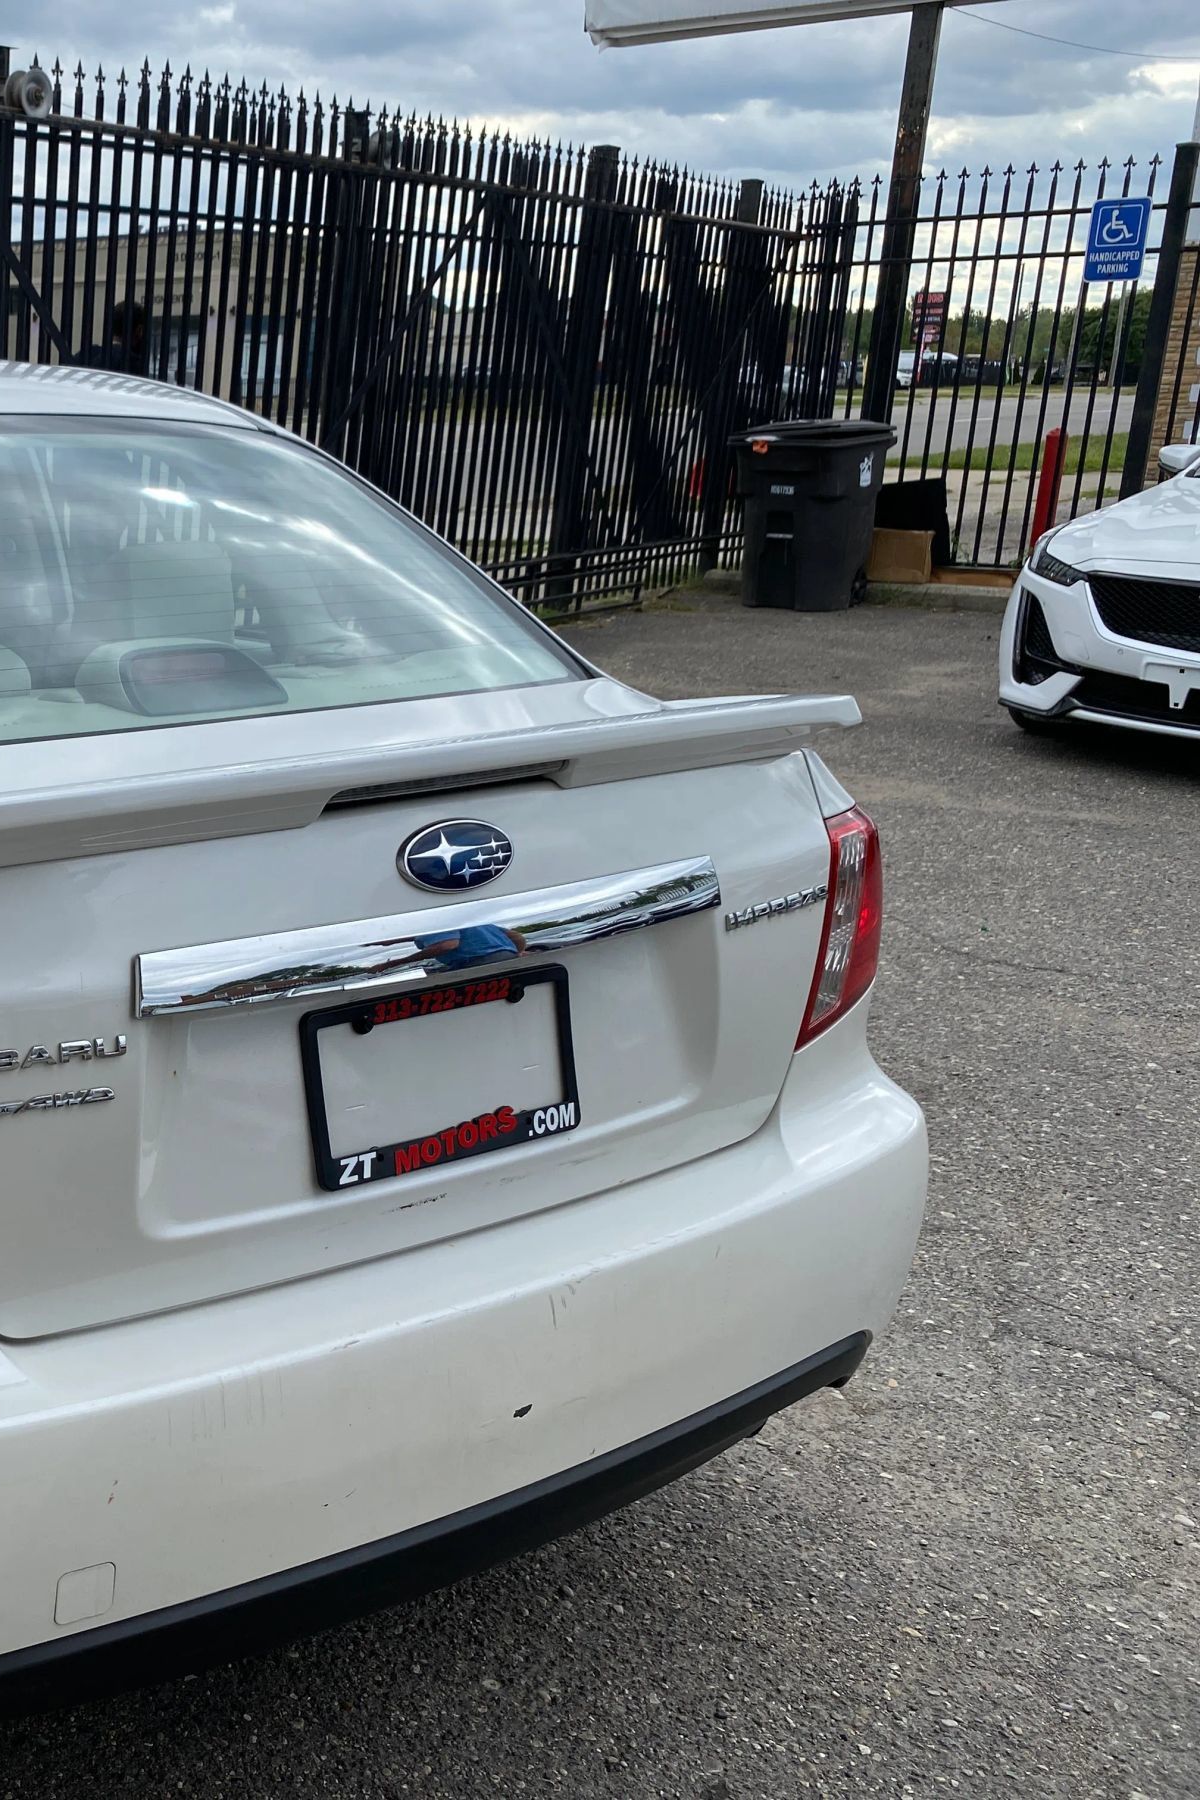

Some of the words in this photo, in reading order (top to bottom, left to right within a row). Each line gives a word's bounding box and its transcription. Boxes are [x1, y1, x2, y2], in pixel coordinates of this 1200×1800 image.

[1089, 250, 1140, 262] HANDICAPPED
[1096, 263, 1129, 274] PARKING
[374, 979, 511, 1025] 313-722-7222
[13, 1086, 116, 1115] AWD
[339, 1151, 377, 1186] ZT
[394, 1105, 518, 1176] MOTORS
[528, 1102, 576, 1137] .COM
